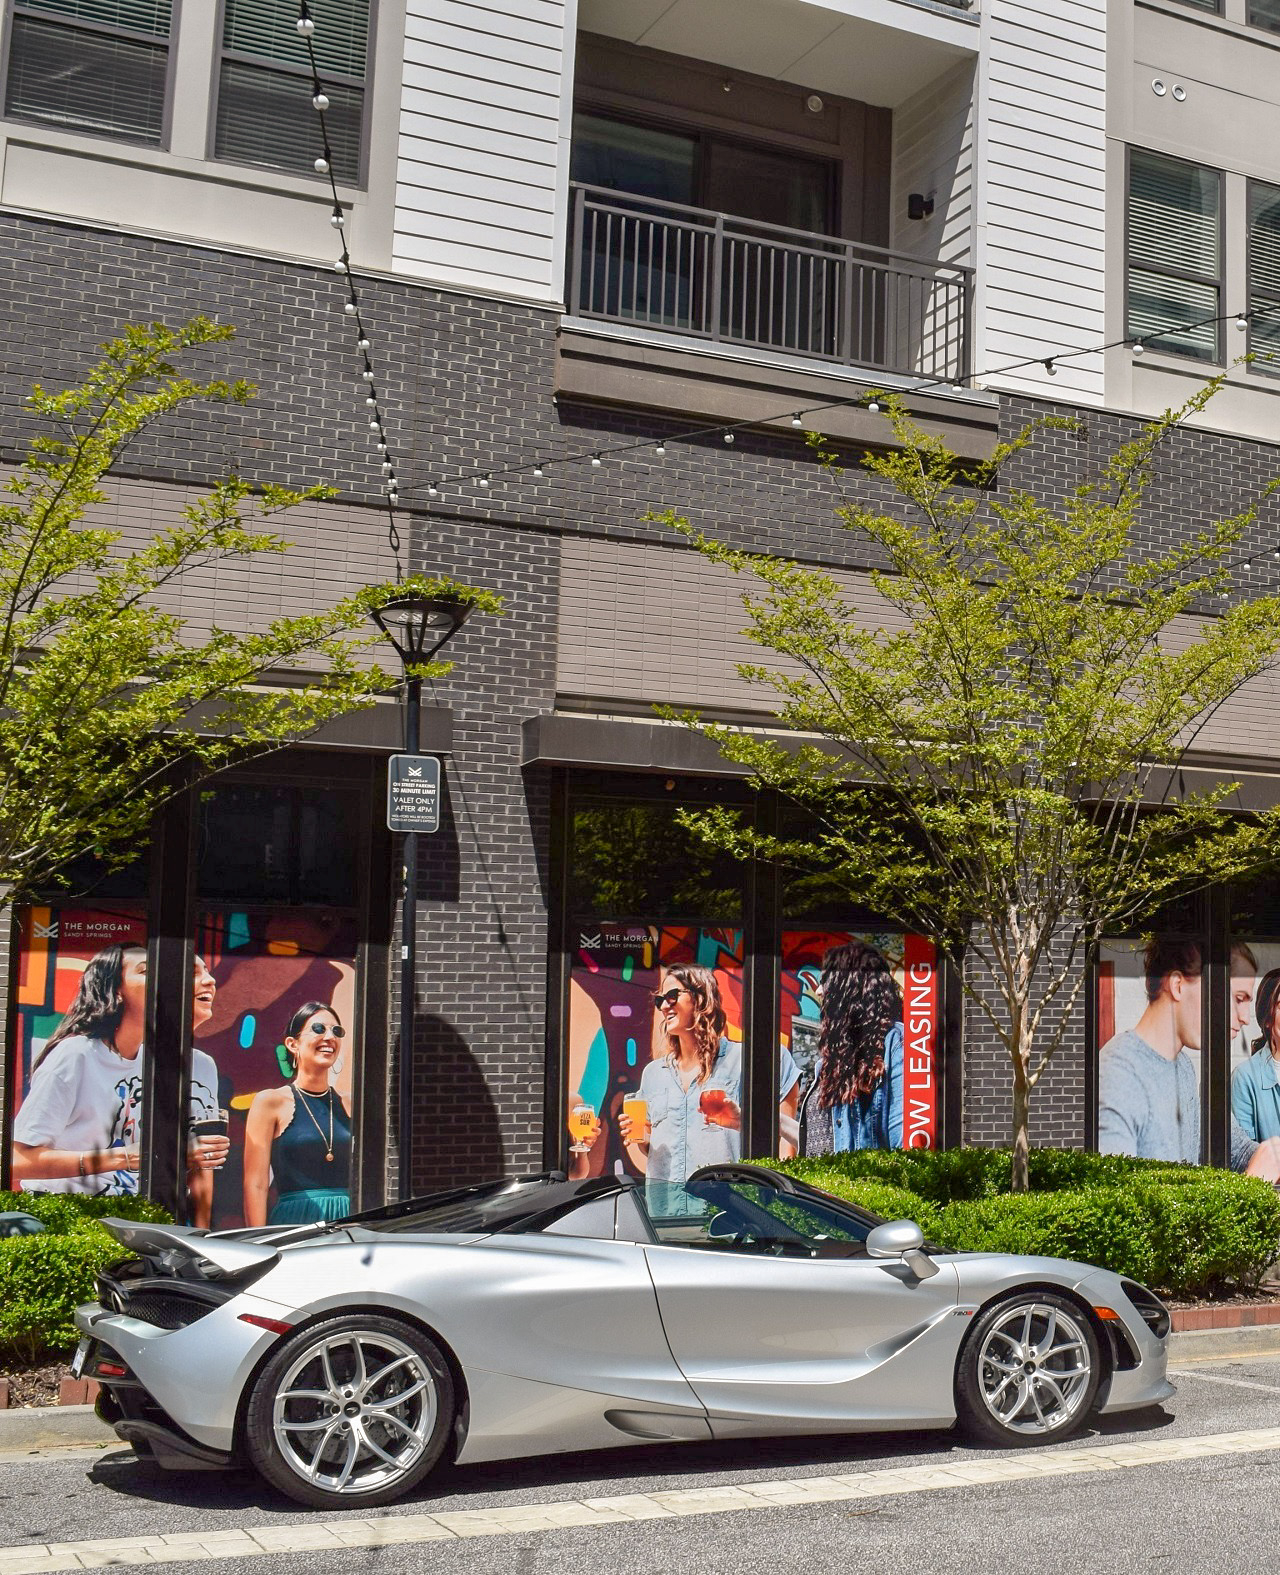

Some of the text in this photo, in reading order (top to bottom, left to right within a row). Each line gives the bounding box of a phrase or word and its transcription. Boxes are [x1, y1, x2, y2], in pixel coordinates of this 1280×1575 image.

[64, 922, 131, 931] THE MORGAN
[908, 962, 932, 1150] OW LEASING
